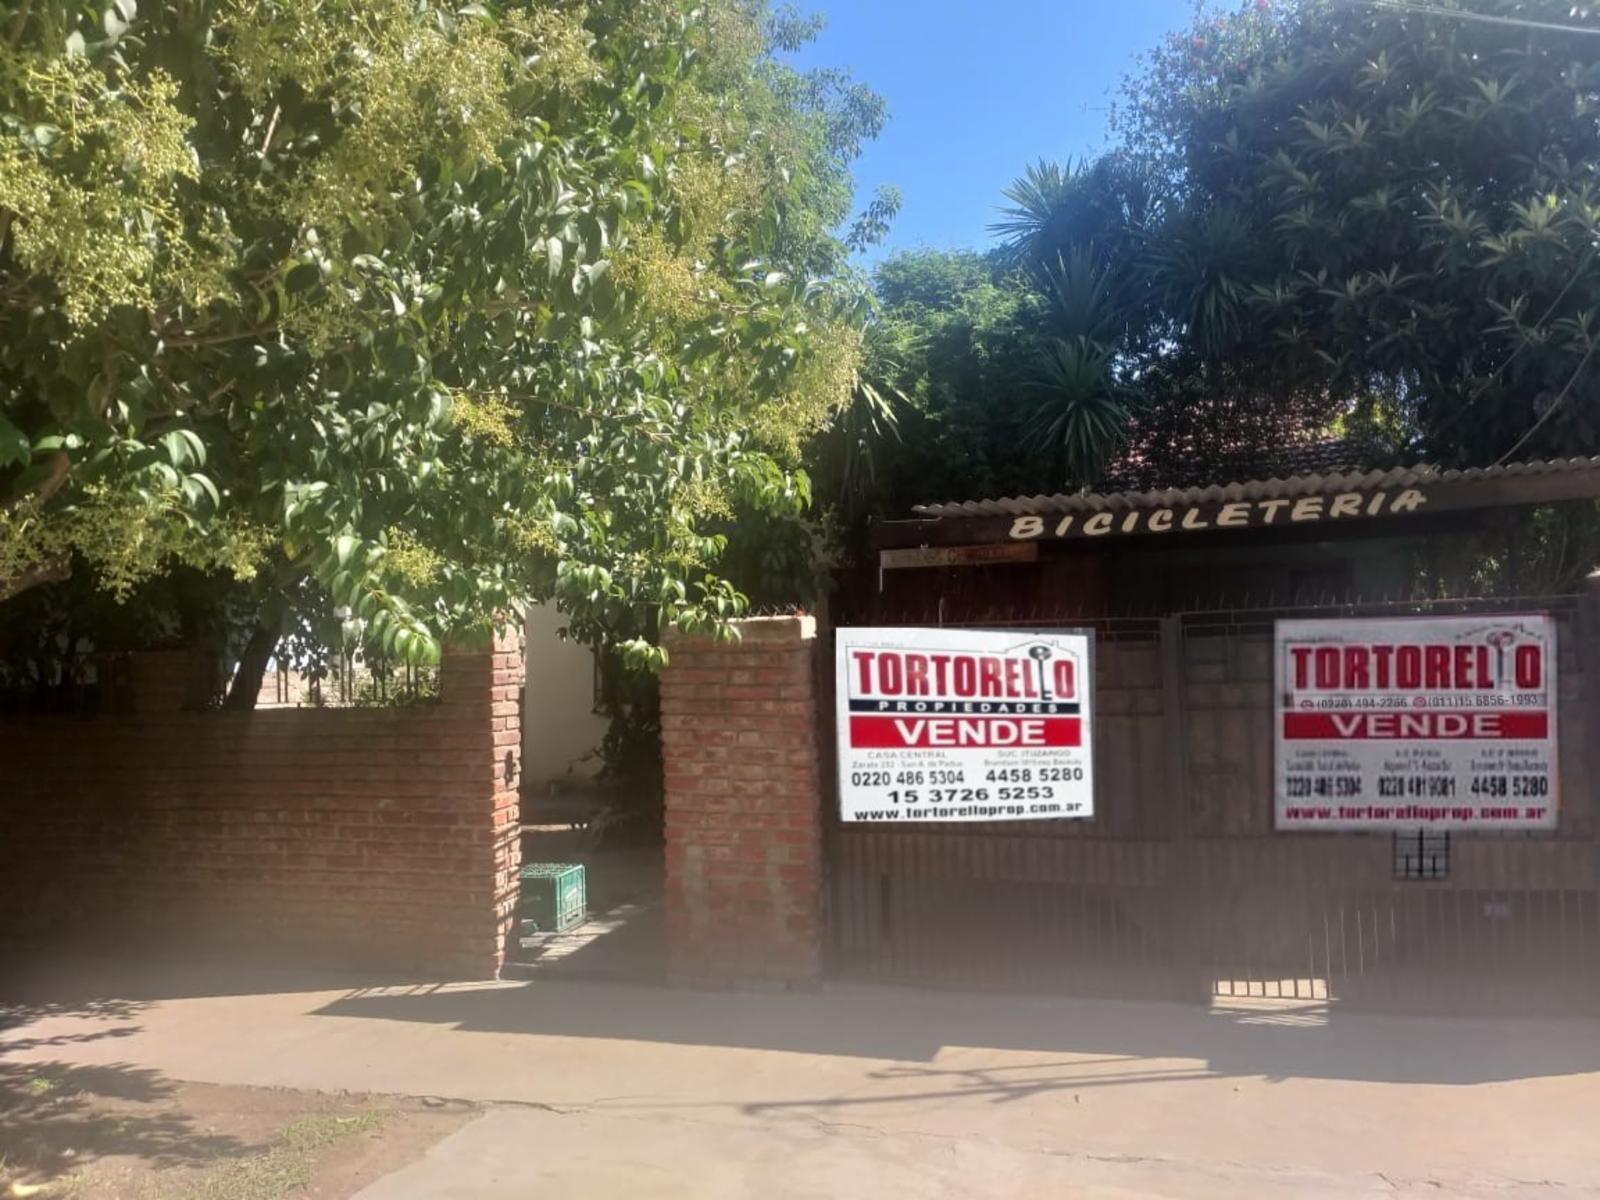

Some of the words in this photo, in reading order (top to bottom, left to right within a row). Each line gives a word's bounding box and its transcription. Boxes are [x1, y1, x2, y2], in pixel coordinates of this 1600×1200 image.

[1008, 489, 1427, 539] BICICLETERIA
[878, 701, 1058, 714] PROPIEDADES
[894, 719, 1047, 745] VENDE
[1331, 714, 1503, 737] VENDE
[867, 751, 898, 760] CASA
[900, 751, 947, 760] CENTRAL
[851, 771, 891, 787] 0220
[896, 770, 925, 786] 486
[929, 770, 965, 785] 5304
[985, 768, 1032, 783] 4458
[1039, 767, 1084, 782] 5280
[887, 789, 919, 804] 15
[929, 787, 990, 803] 3726
[998, 785, 1055, 801] 5253
[1471, 775, 1507, 797] 4458
[1512, 775, 1548, 797] 5280
[854, 801, 1083, 821] www.tortorelloprop.com.ar
